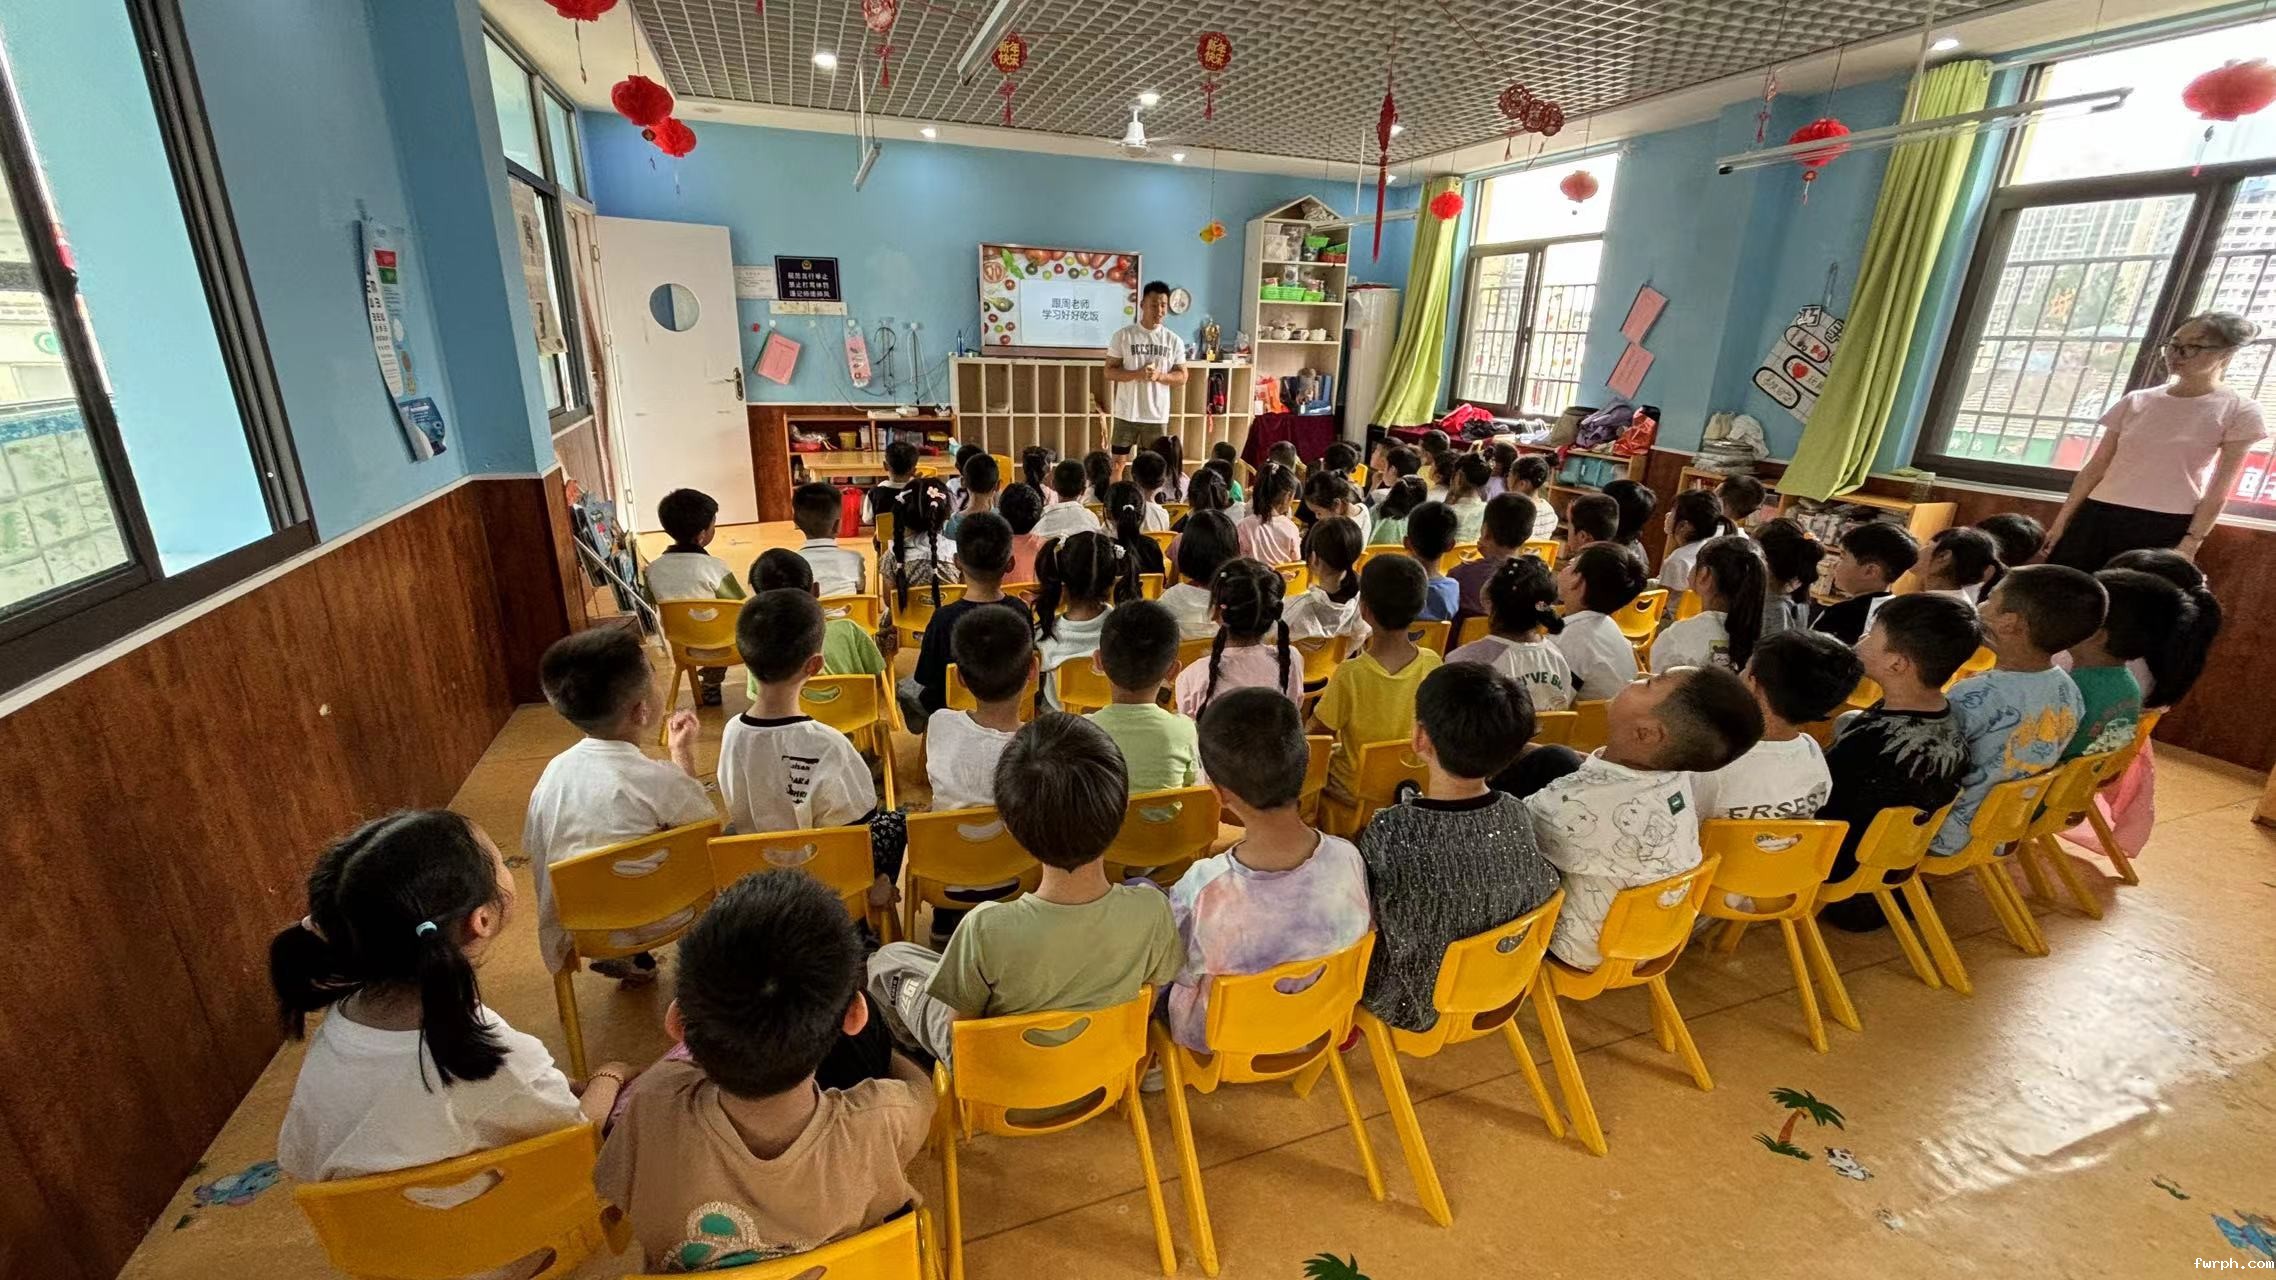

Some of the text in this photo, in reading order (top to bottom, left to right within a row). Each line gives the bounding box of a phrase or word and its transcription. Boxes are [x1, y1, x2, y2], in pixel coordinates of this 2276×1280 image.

[998, 41, 1020, 54] 新年
[998, 52, 1020, 67] 快乐
[1204, 51, 1225, 66] 快乐
[1051, 297, 1090, 310] 跟周老师
[1042, 309, 1099, 322] 学习好好吃饭
